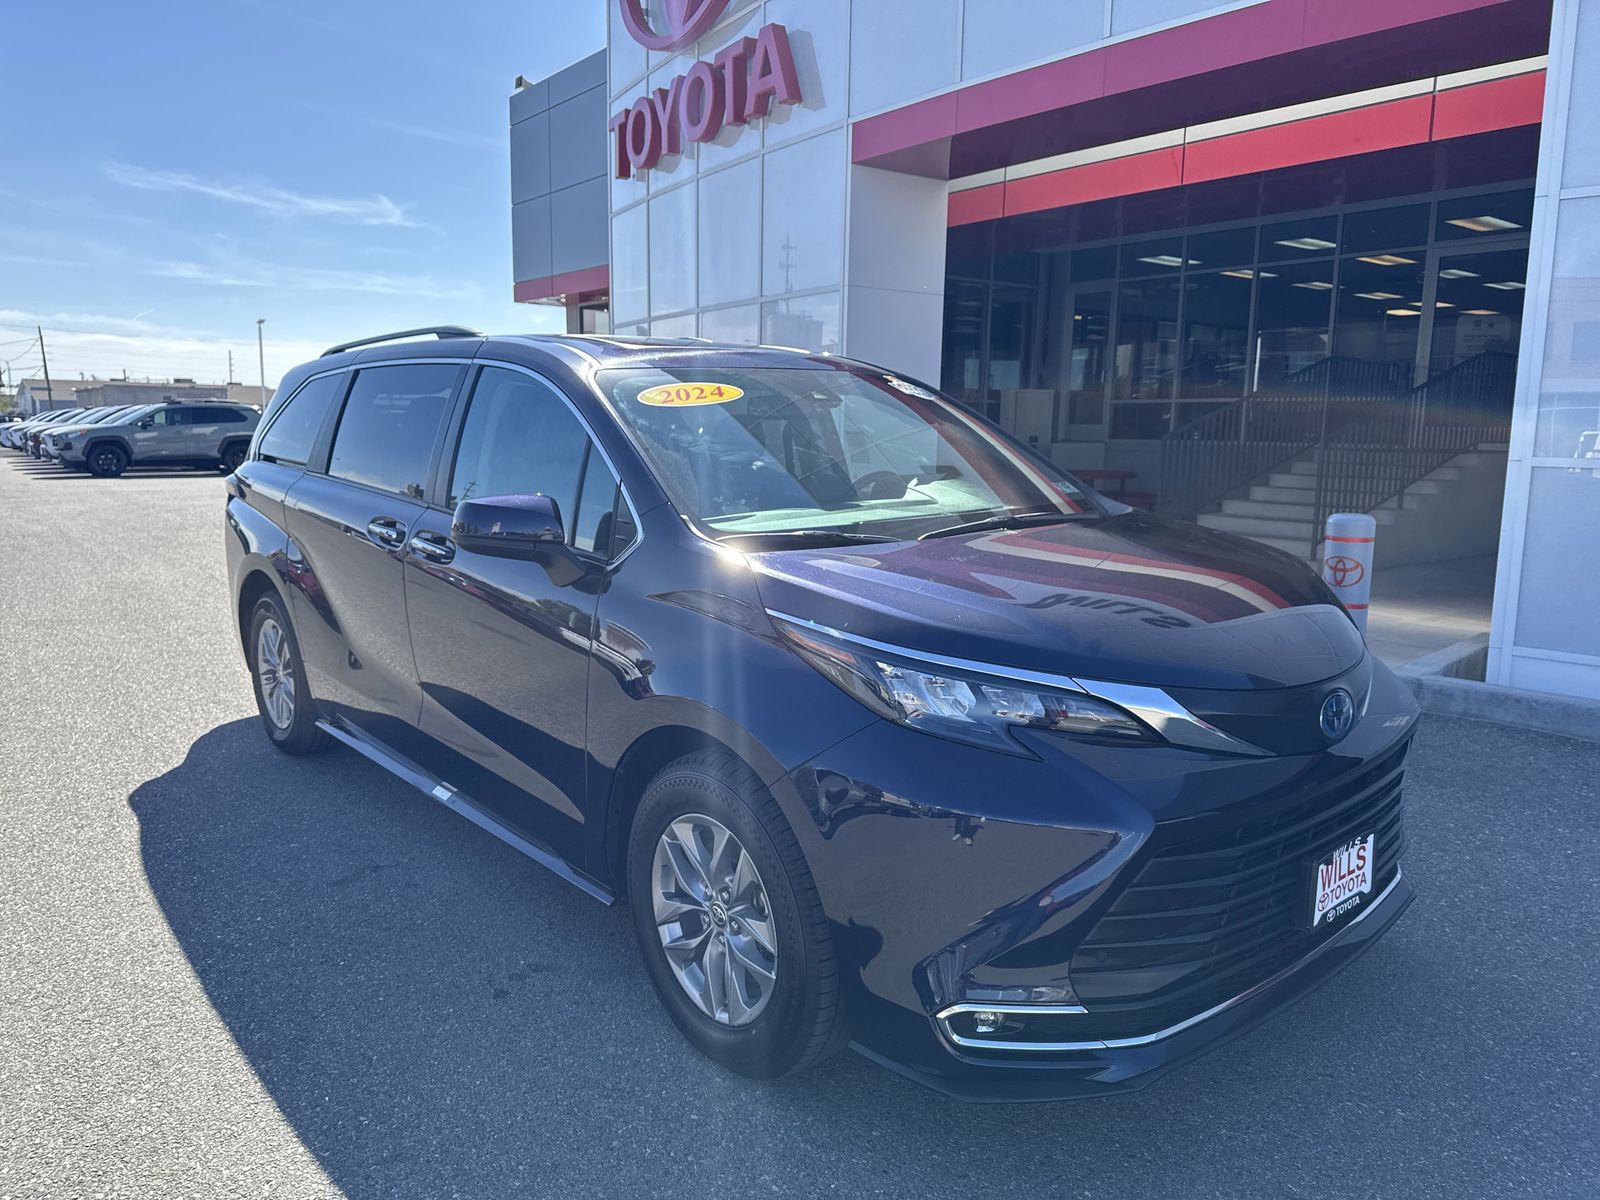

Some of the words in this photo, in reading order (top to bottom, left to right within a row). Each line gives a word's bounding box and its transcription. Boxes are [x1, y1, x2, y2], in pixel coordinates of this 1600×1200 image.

[609, 23, 802, 179] TOYOTA
[661, 385, 725, 404] 2024
[1321, 845, 1366, 892] WILLS
[1330, 872, 1367, 903] TOYOTA
[1336, 895, 1360, 916] TOYOTA
